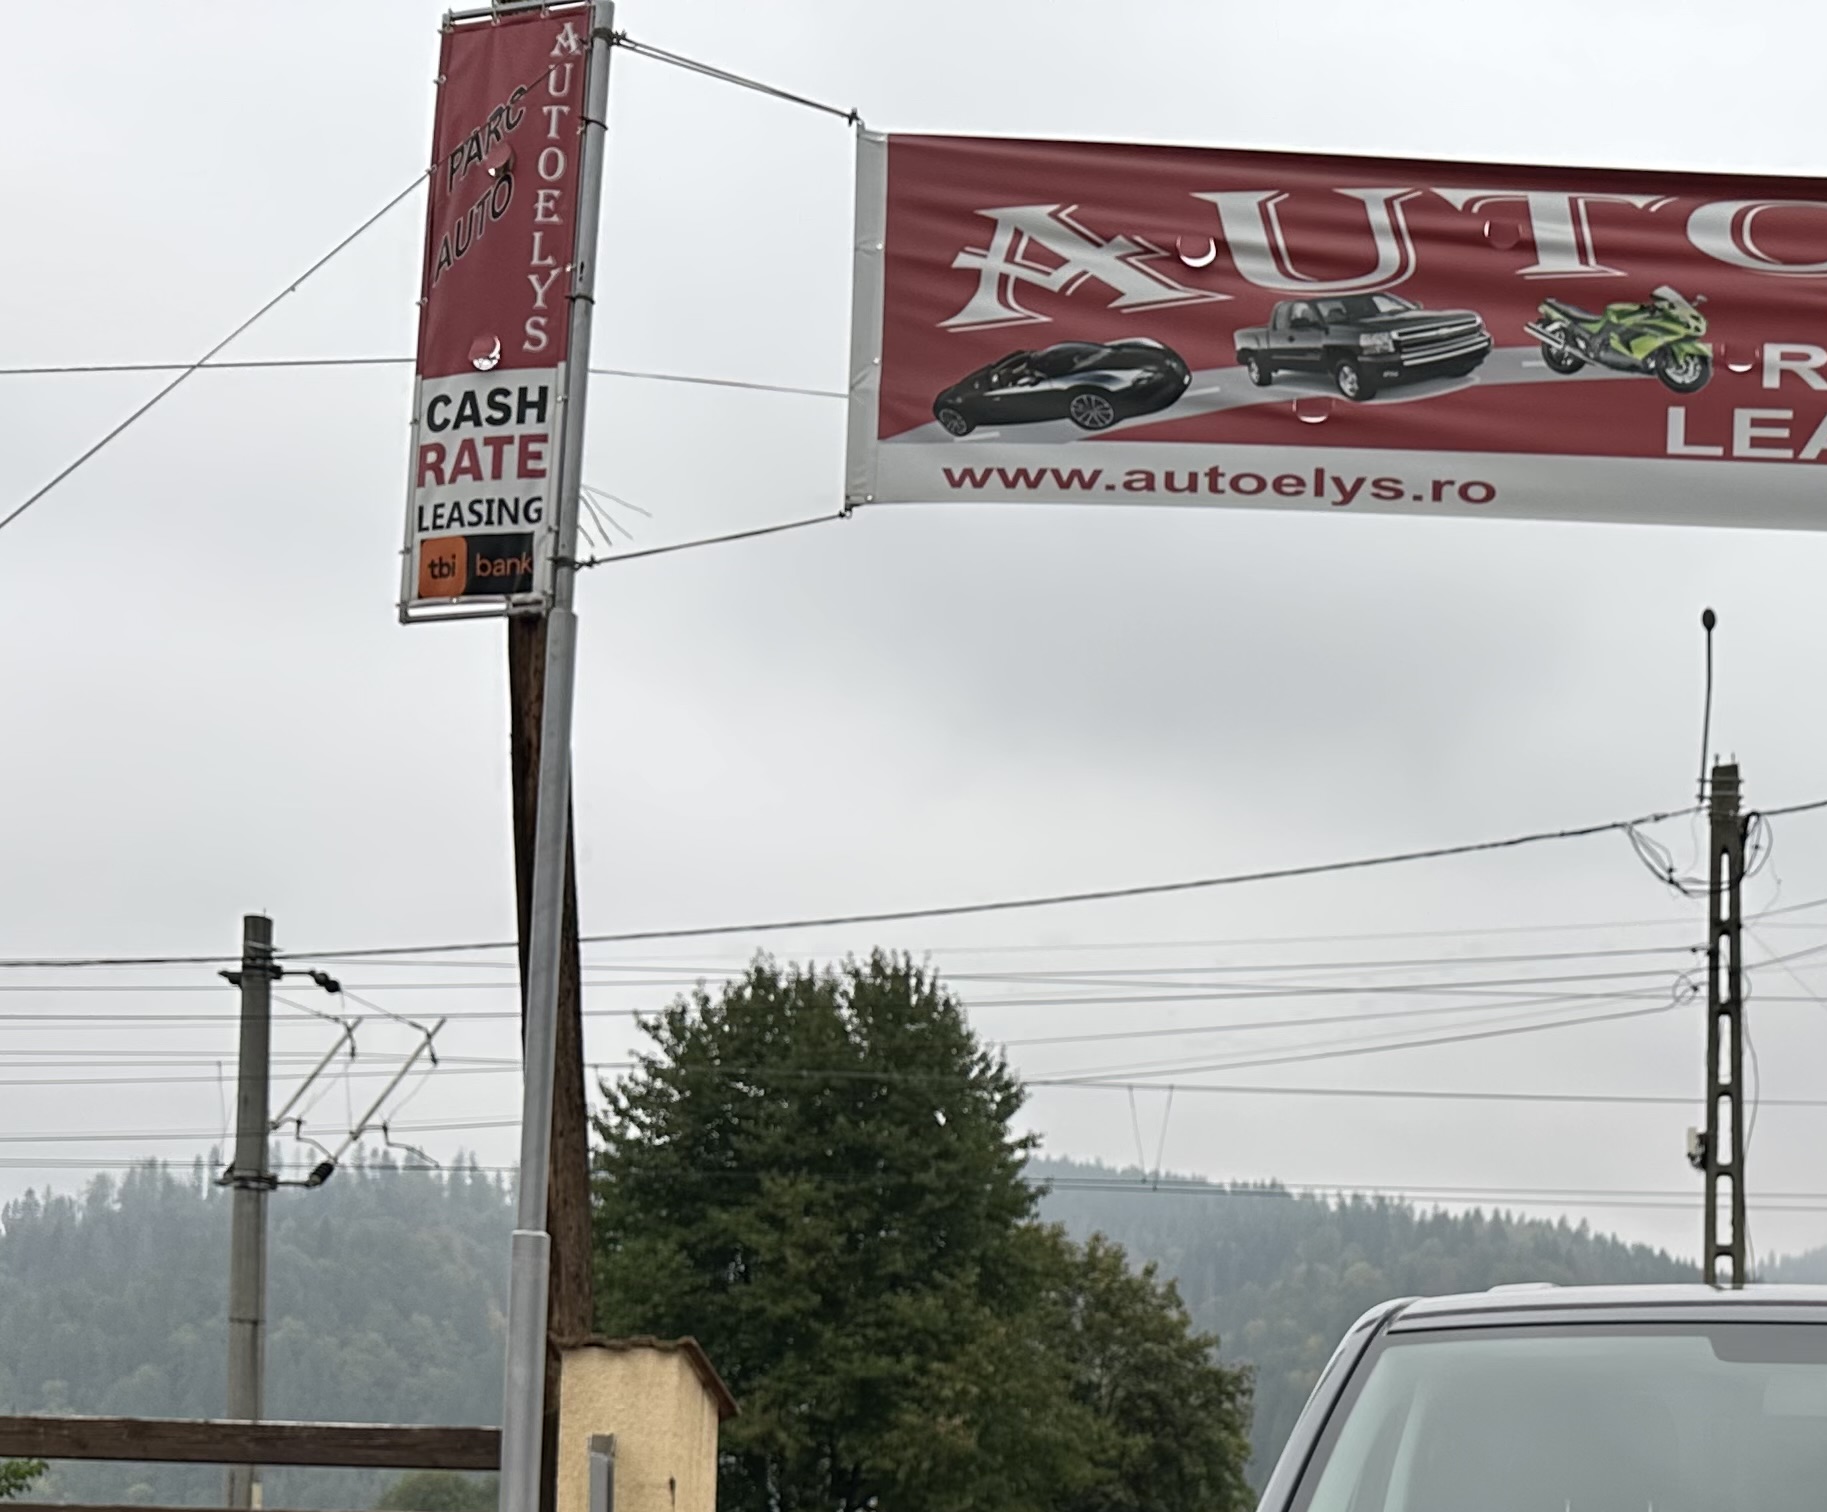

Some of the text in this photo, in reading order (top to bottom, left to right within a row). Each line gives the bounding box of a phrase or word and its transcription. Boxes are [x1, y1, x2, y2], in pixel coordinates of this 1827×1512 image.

[447, 85, 528, 194] PARC
[522, 22, 582, 353] AUTOELYS
[433, 172, 514, 285] AUTO
[426, 385, 549, 434] CASH
[417, 433, 548, 488] RATE
[941, 463, 1497, 506] www.autoelys.ro
[417, 495, 543, 532] LEASING
[427, 554, 533, 580] tbi bank
